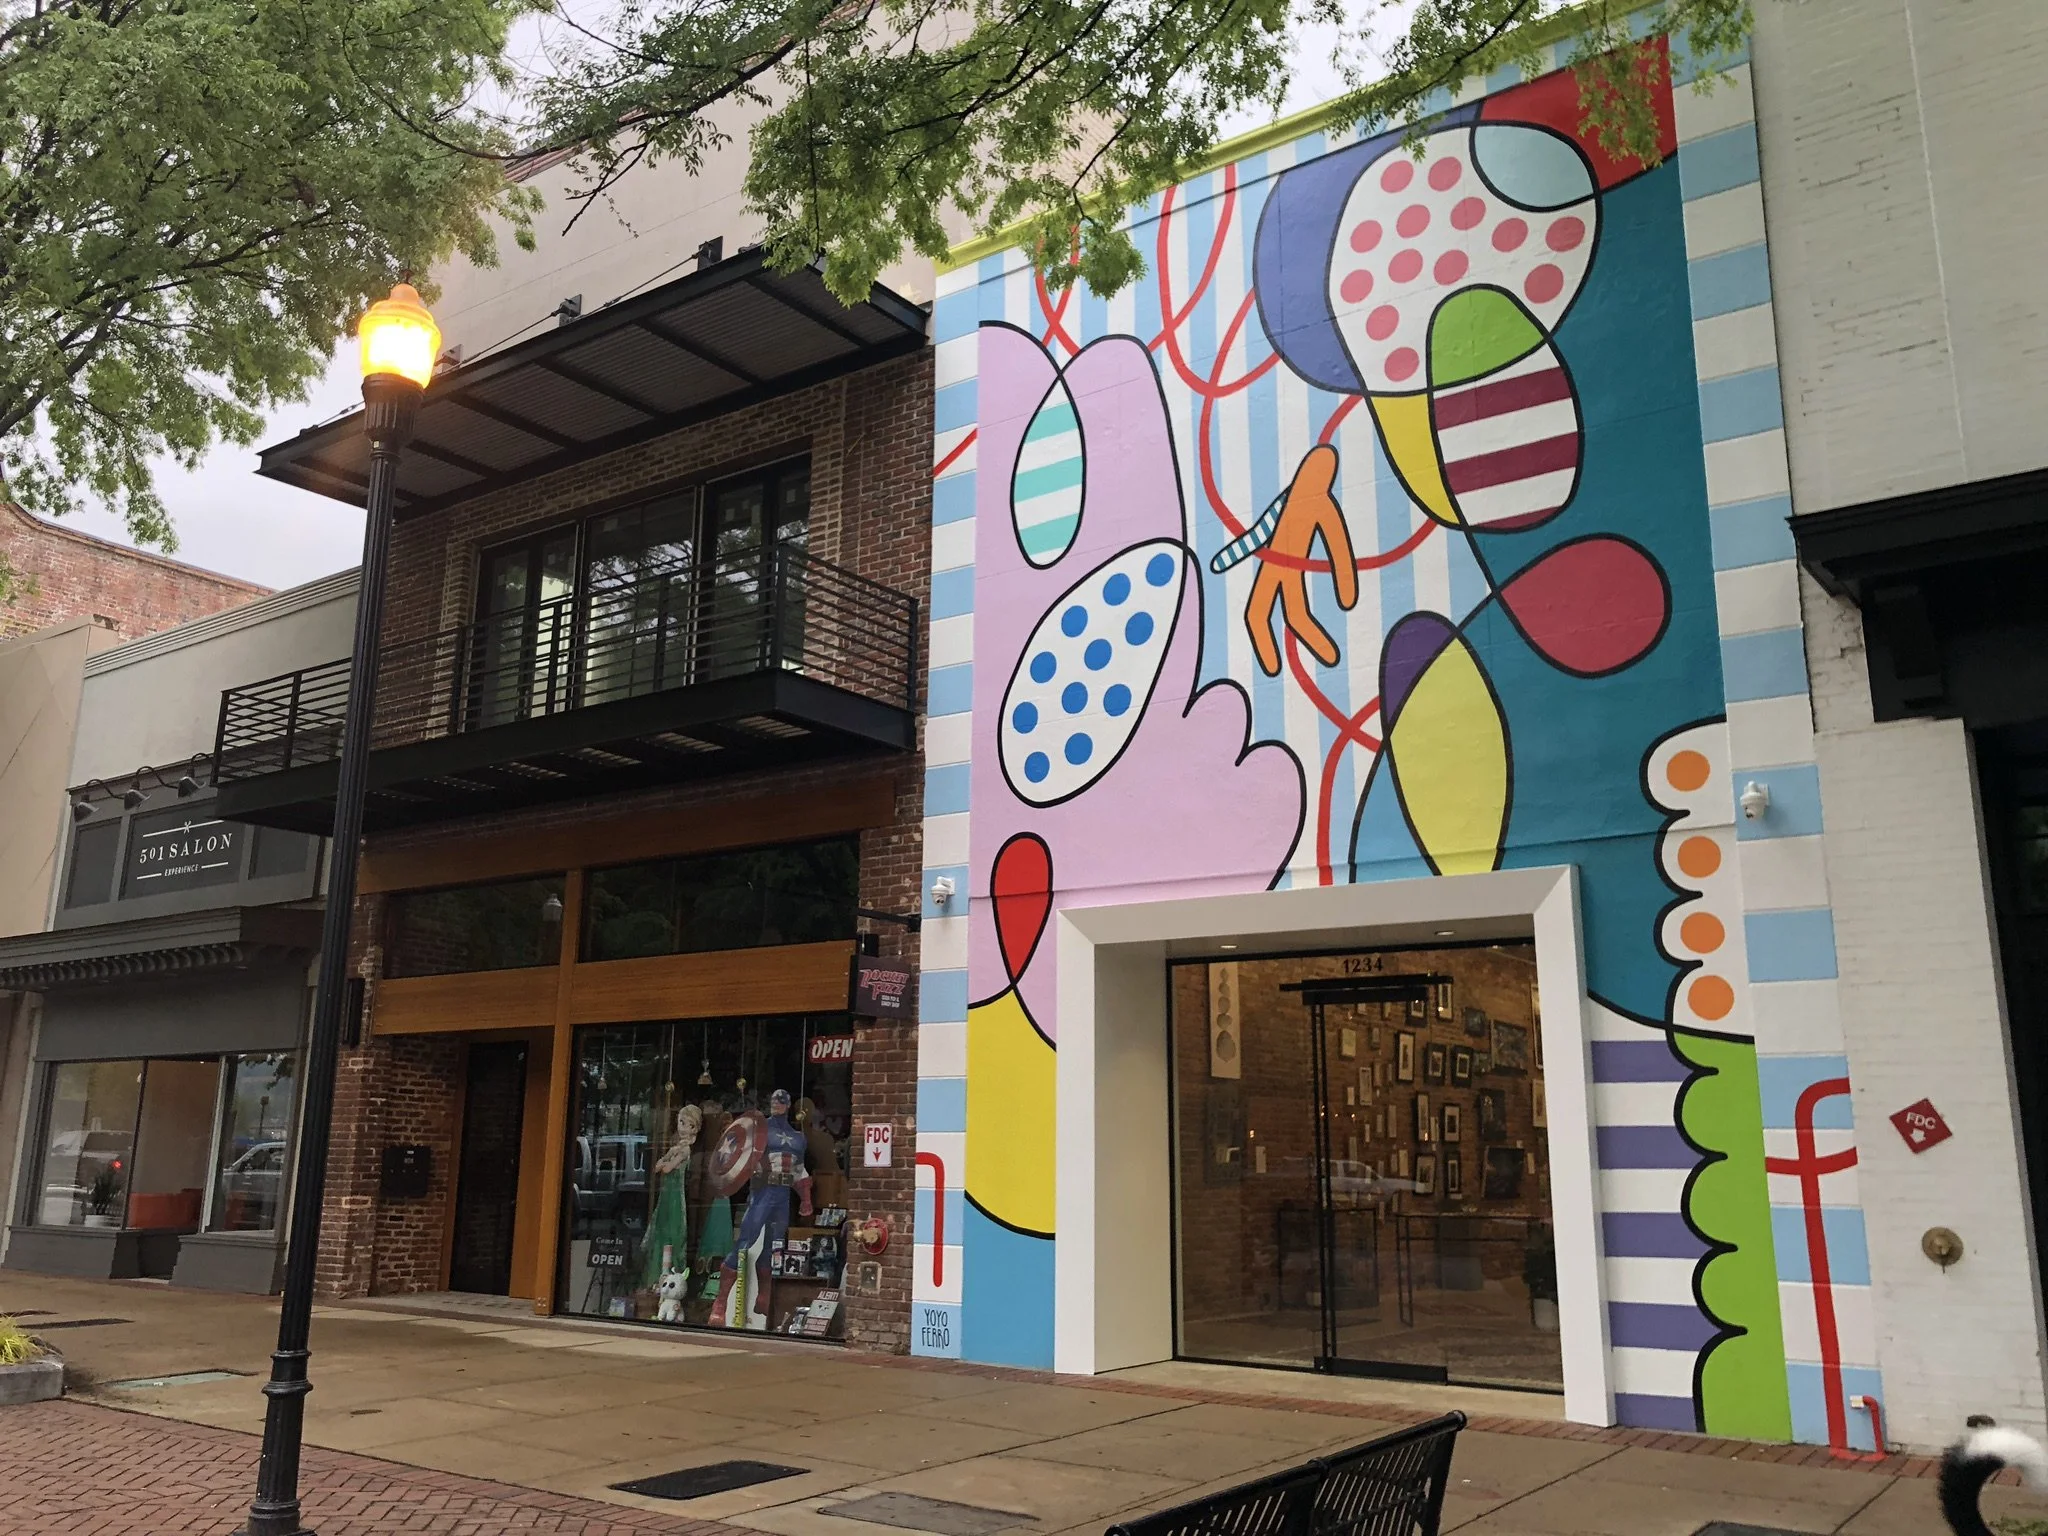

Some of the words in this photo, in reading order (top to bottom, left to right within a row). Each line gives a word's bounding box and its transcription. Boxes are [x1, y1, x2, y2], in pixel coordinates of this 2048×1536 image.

[139, 846, 164, 864] 501
[169, 833, 233, 858] SALON
[164, 864, 199, 876] EXPERIENCE
[1343, 957, 1383, 973] 1234
[811, 1038, 854, 1059] OPEN
[1906, 1111, 1937, 1130] FDC
[866, 1127, 890, 1144] FDC
[591, 1253, 624, 1266] OPEN
[924, 1308, 949, 1328] YOYO
[921, 1326, 950, 1350] FERRO
